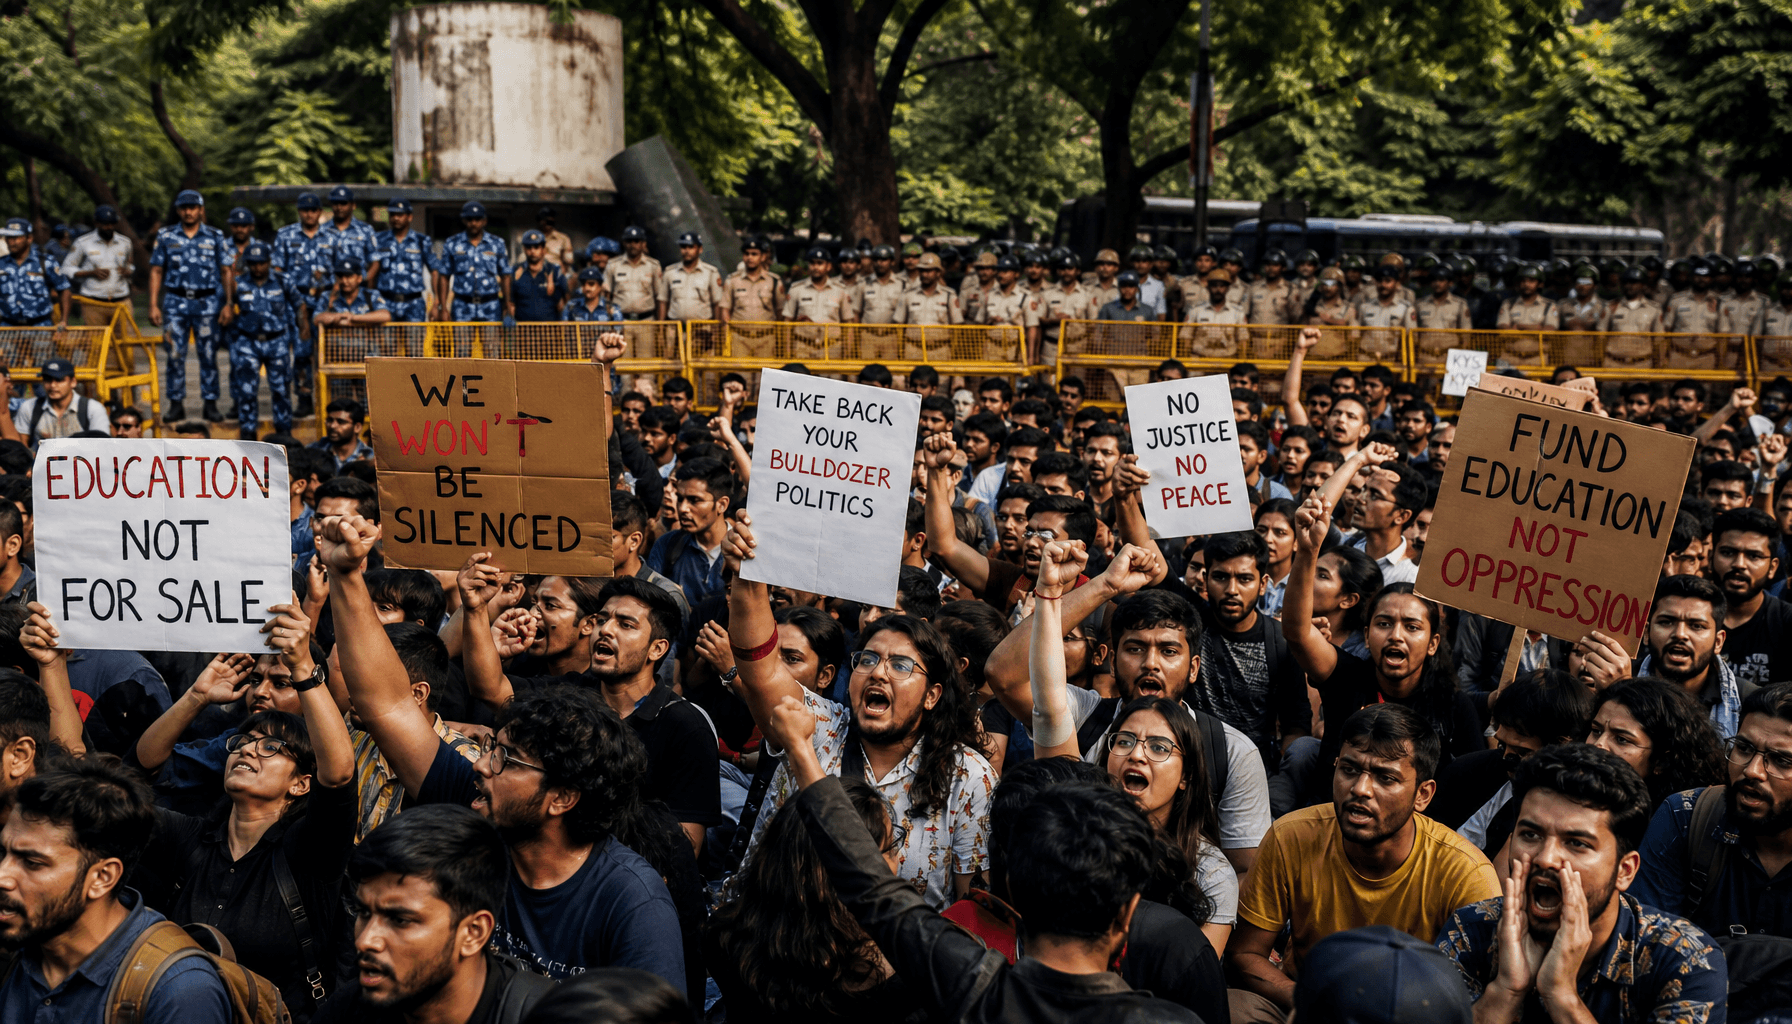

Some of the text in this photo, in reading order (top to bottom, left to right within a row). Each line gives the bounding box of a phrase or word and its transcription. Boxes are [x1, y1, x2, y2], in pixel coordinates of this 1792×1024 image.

[411, 374, 485, 407] WE
[772, 388, 893, 426] TAKE BACK
[1167, 392, 1199, 416] NO
[392, 412, 553, 458] WON'T
[803, 424, 858, 452] YOUR
[1146, 420, 1232, 449] JUSTICE
[1509, 414, 1627, 473] FUND
[46, 455, 270, 500] EDUCATION
[436, 466, 482, 498] BE
[770, 449, 891, 489] BULLDOZER
[1176, 454, 1207, 476] NO
[775, 481, 874, 518] POLITICS
[1161, 482, 1232, 510] PEACE
[1461, 456, 1666, 539] EDUCATION
[122, 519, 209, 561] NOT
[394, 507, 581, 553] SILENCED
[1508, 516, 1588, 563] NOT
[62, 578, 266, 625] FOR SALE
[1441, 547, 1651, 639] OPPRESSION
